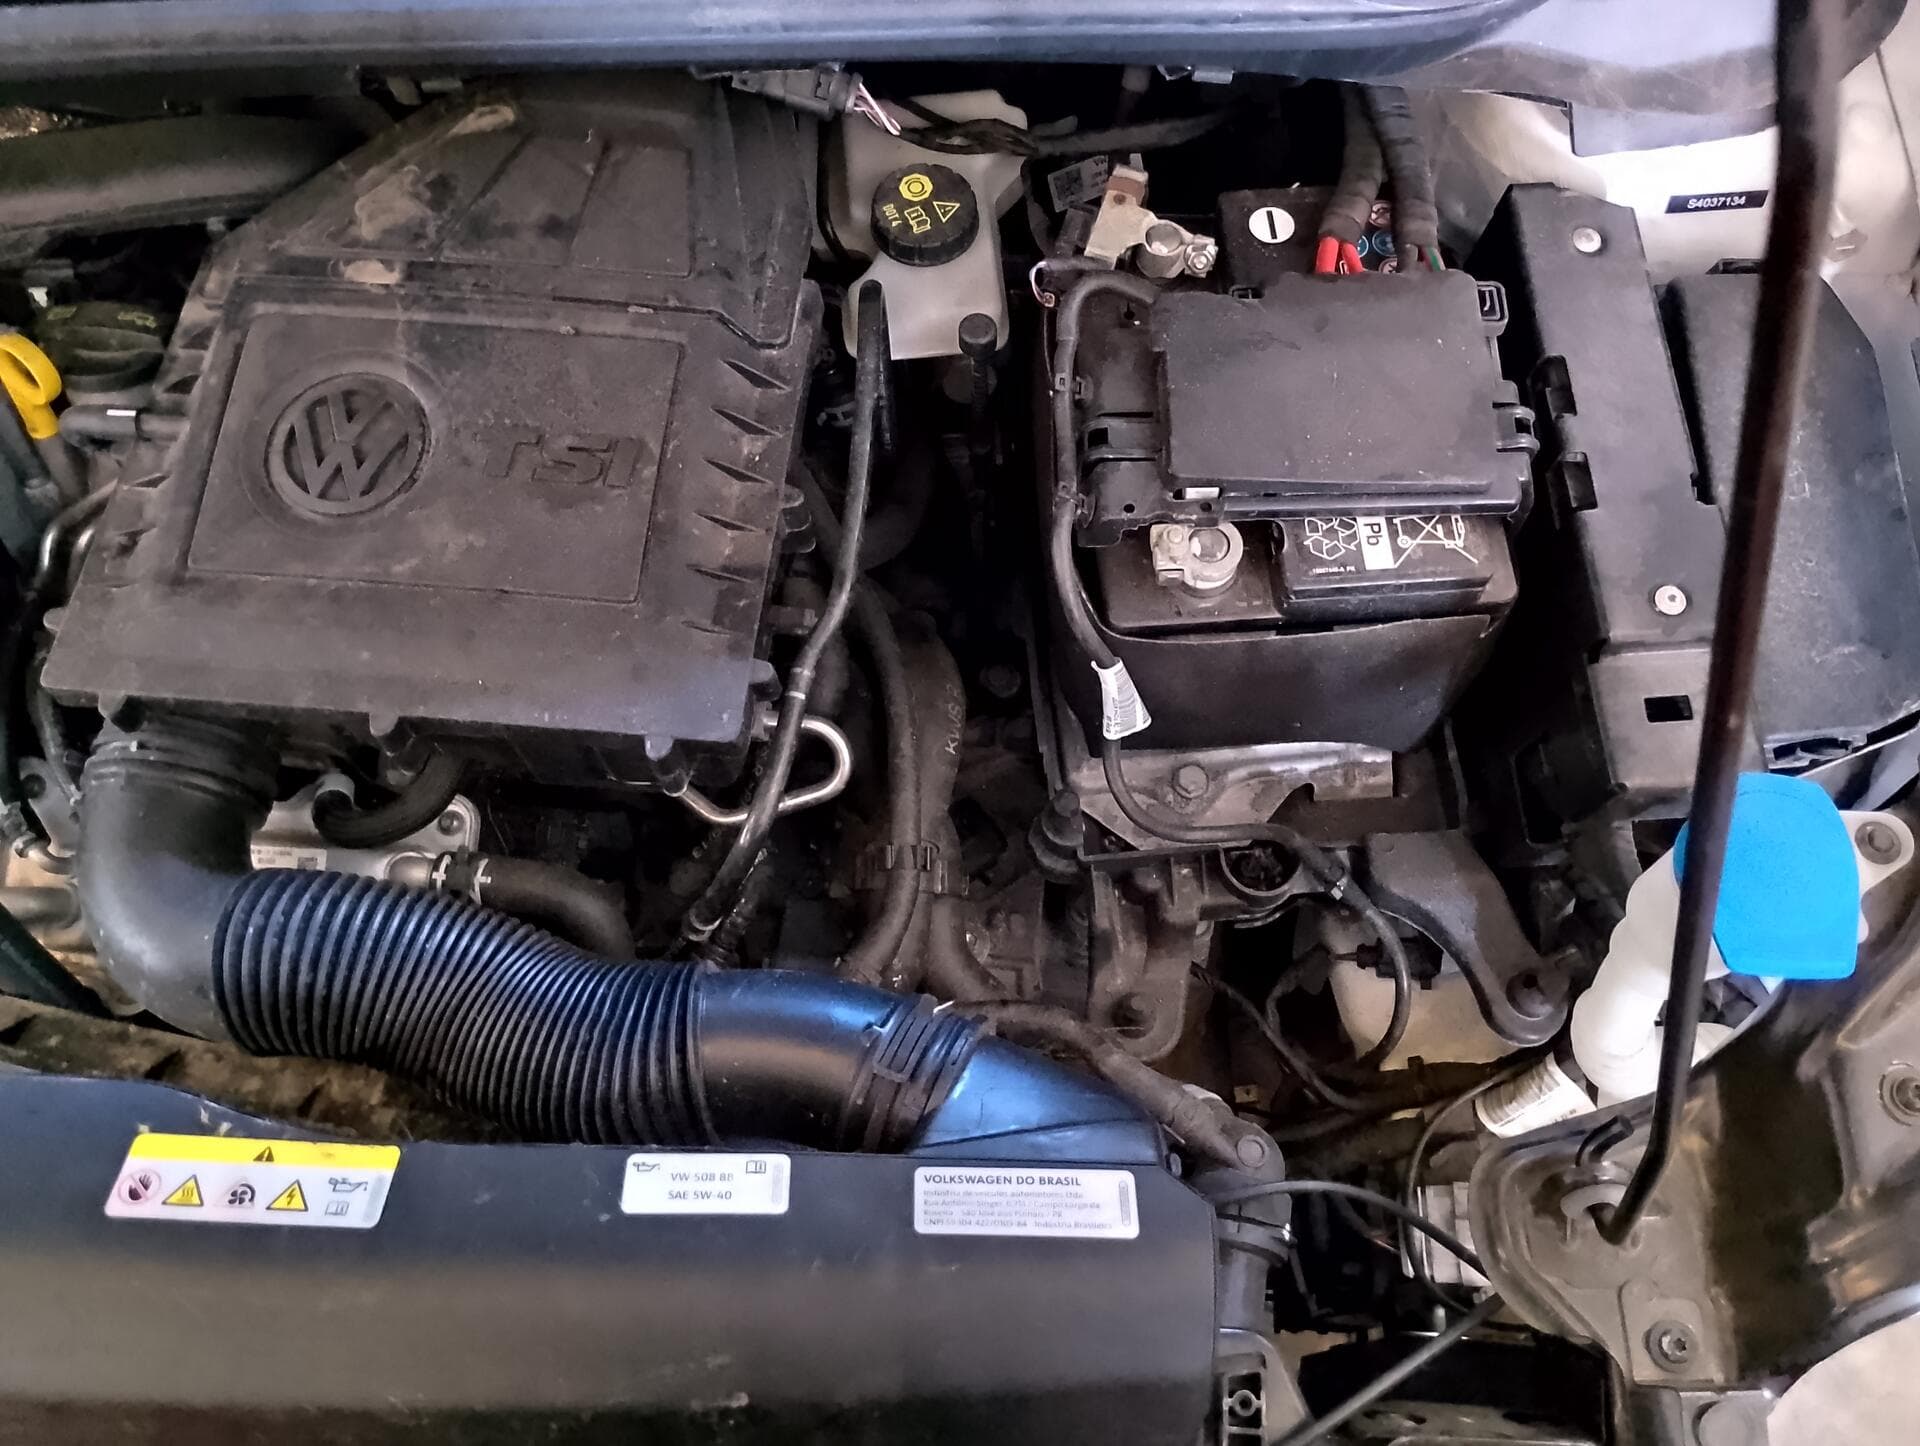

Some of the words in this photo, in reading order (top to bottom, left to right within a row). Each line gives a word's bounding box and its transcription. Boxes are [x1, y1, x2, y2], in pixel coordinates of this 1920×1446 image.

[882, 203, 900, 220] DOT
[273, 379, 424, 509] VW
[1363, 522, 1383, 547] Pb
[671, 1172, 690, 1182] VW
[923, 1174, 1012, 1185] VOLKSWAGEN
[1016, 1175, 1035, 1186] DO
[1039, 1176, 1082, 1187] BRASIL
[668, 1190, 688, 1200] SAE
